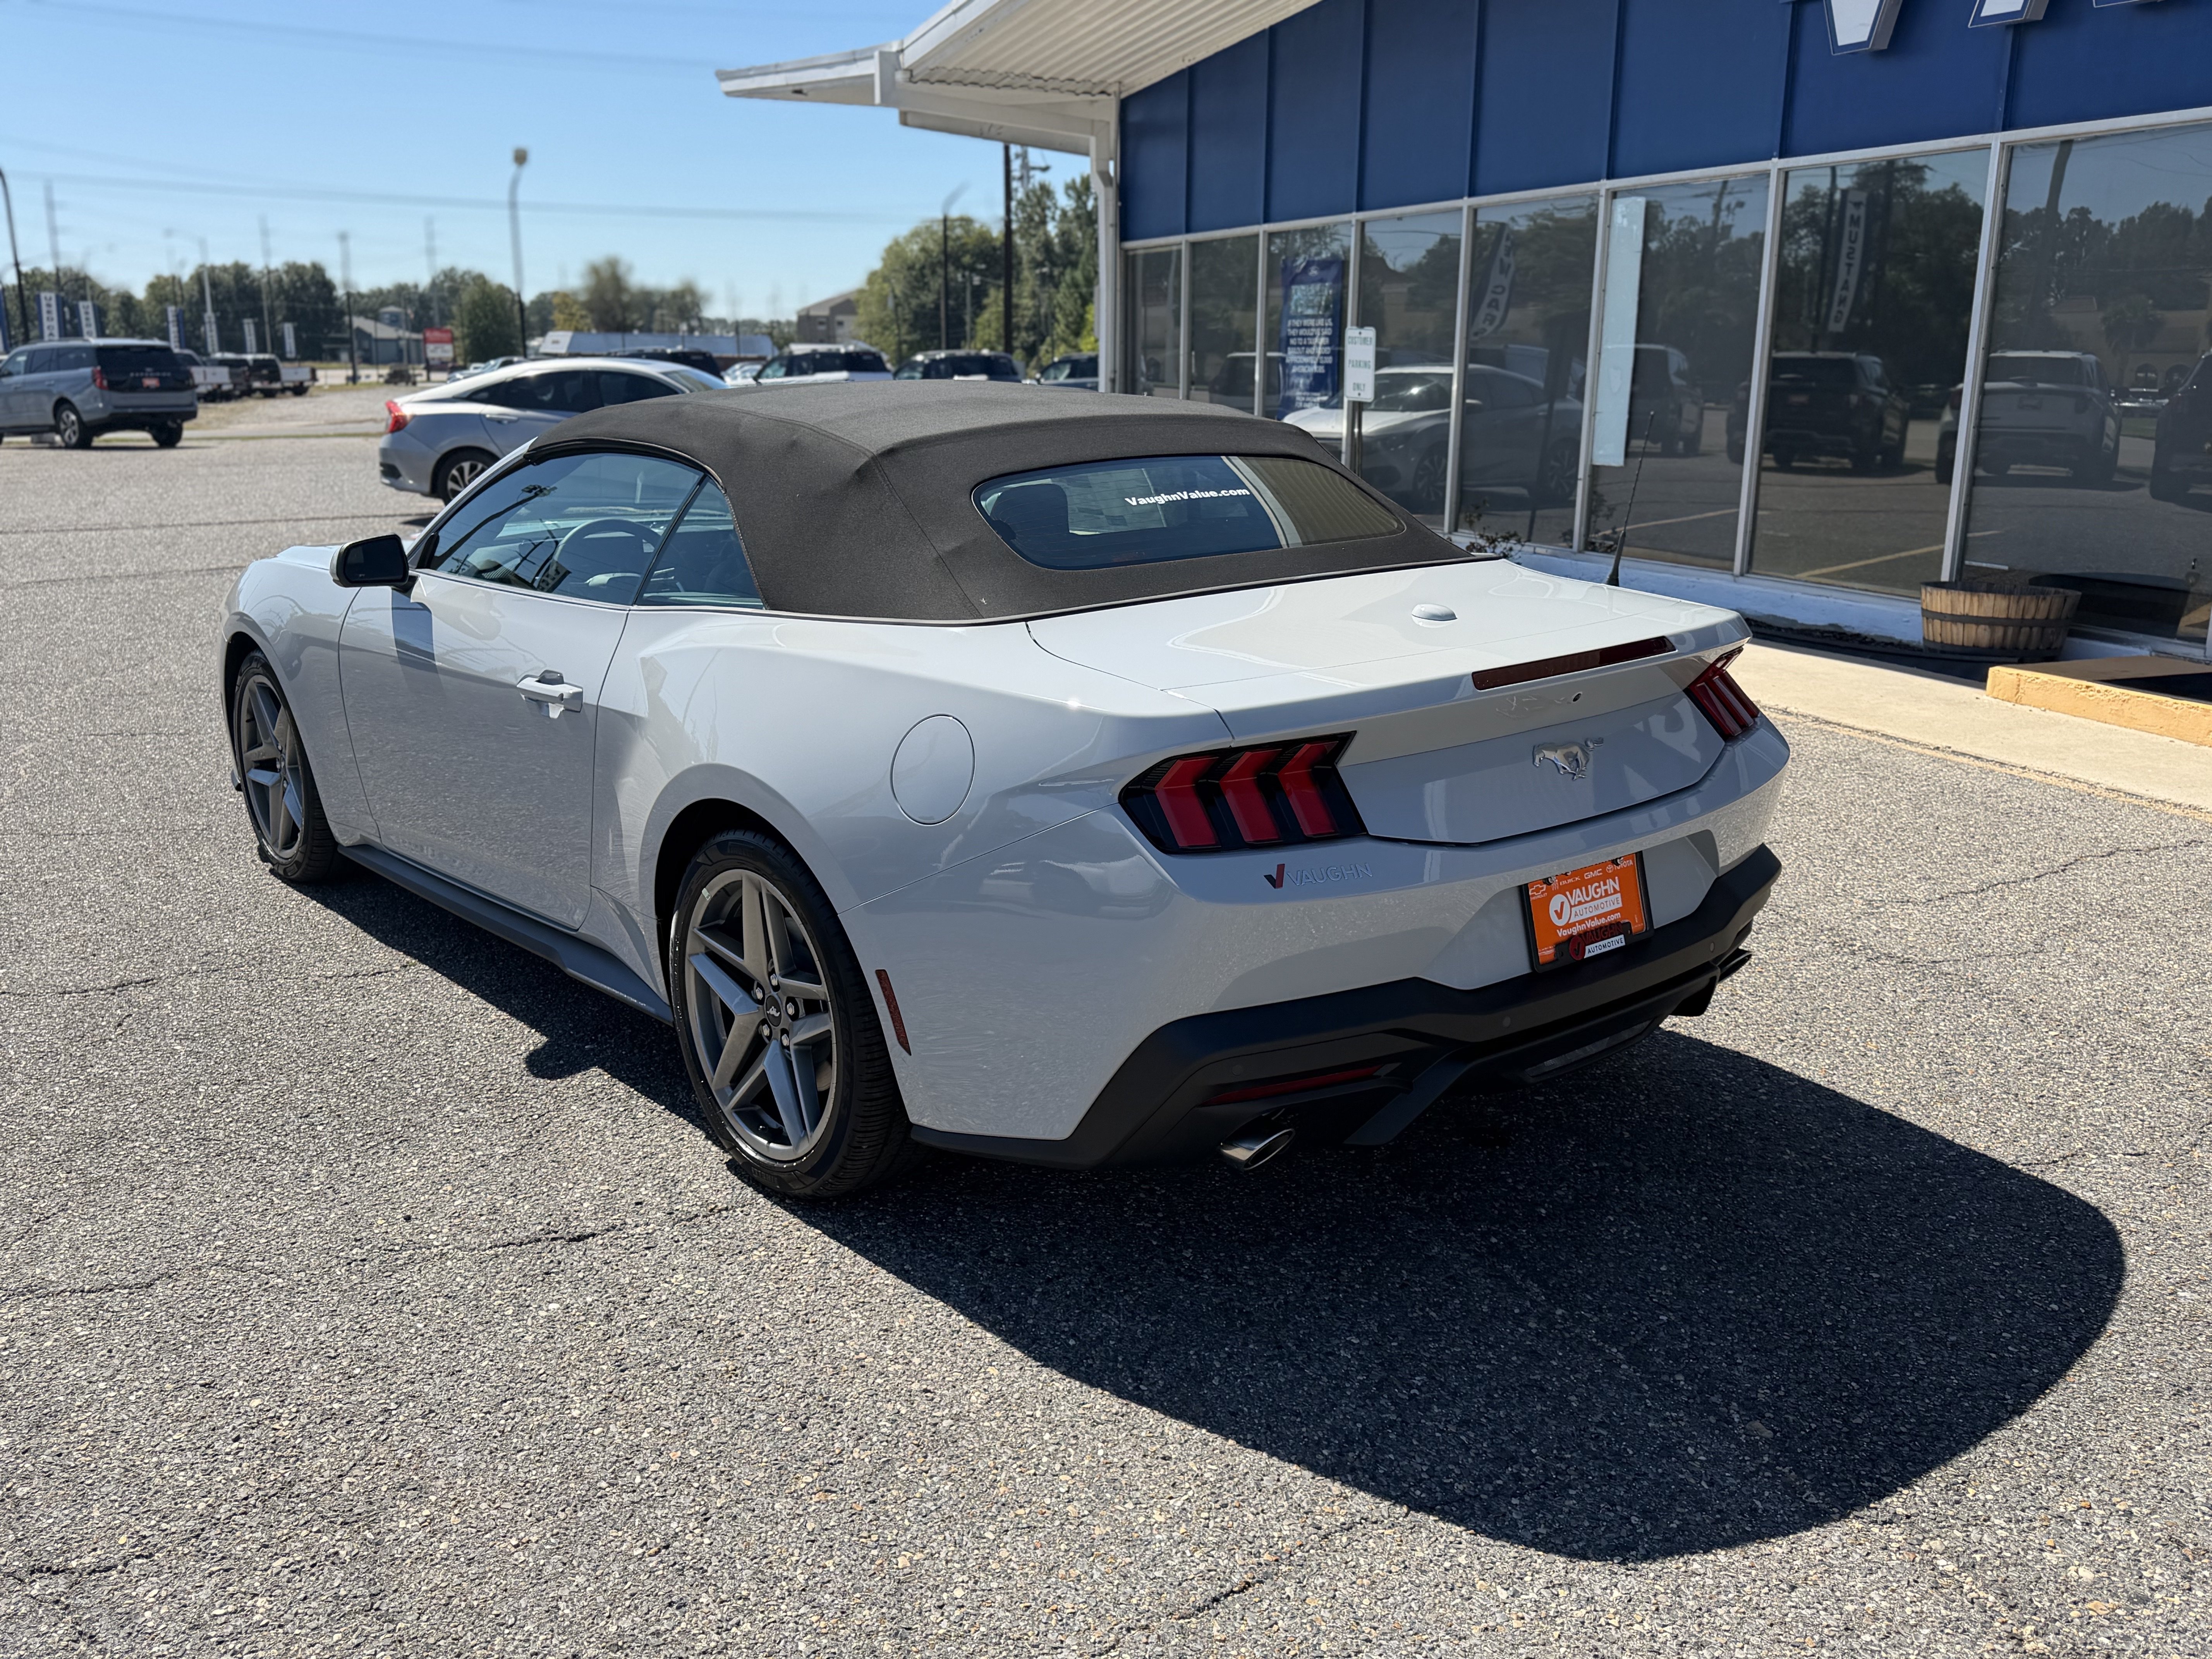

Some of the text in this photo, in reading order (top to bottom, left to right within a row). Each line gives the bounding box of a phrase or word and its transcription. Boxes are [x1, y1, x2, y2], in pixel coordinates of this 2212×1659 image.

[1348, 336, 1372, 345] CUSTOMER
[1348, 359, 1371, 369] PARKING
[1353, 382, 1365, 392] ONLY
[1125, 488, 1250, 506] VaughnValue.com
[1286, 862, 1373, 886] VAUGHN
[1560, 876, 1581, 886] BUICK
[1584, 869, 1603, 879] GMC
[1566, 876, 1620, 905] VAUGHN
[1574, 897, 1620, 918] AUTOMOTIVE
[1557, 912, 1621, 937] VaughnValue.com
[1581, 921, 1623, 944] VAUGHN
[1588, 938, 1623, 954] AUTOMOTIVE
